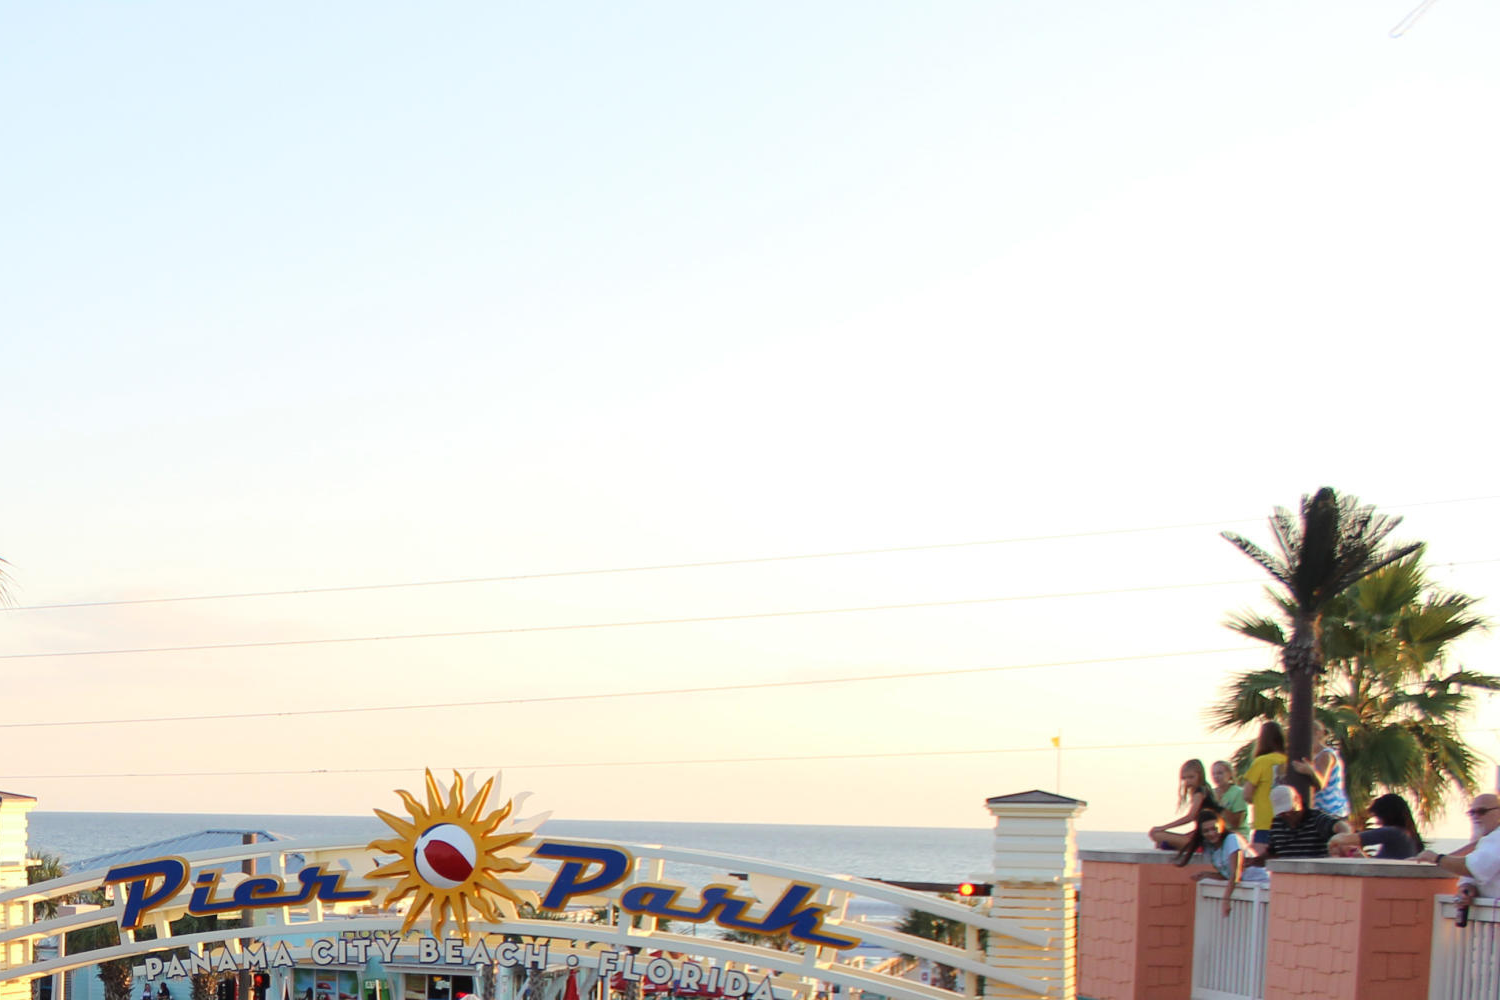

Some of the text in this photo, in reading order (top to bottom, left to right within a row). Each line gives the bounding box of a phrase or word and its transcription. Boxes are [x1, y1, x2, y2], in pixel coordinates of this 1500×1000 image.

[103, 839, 862, 950] Pier Park
[145, 940, 295, 981] PANAMA
[311, 937, 400, 965] CITY
[419, 937, 548, 970] BEACH
